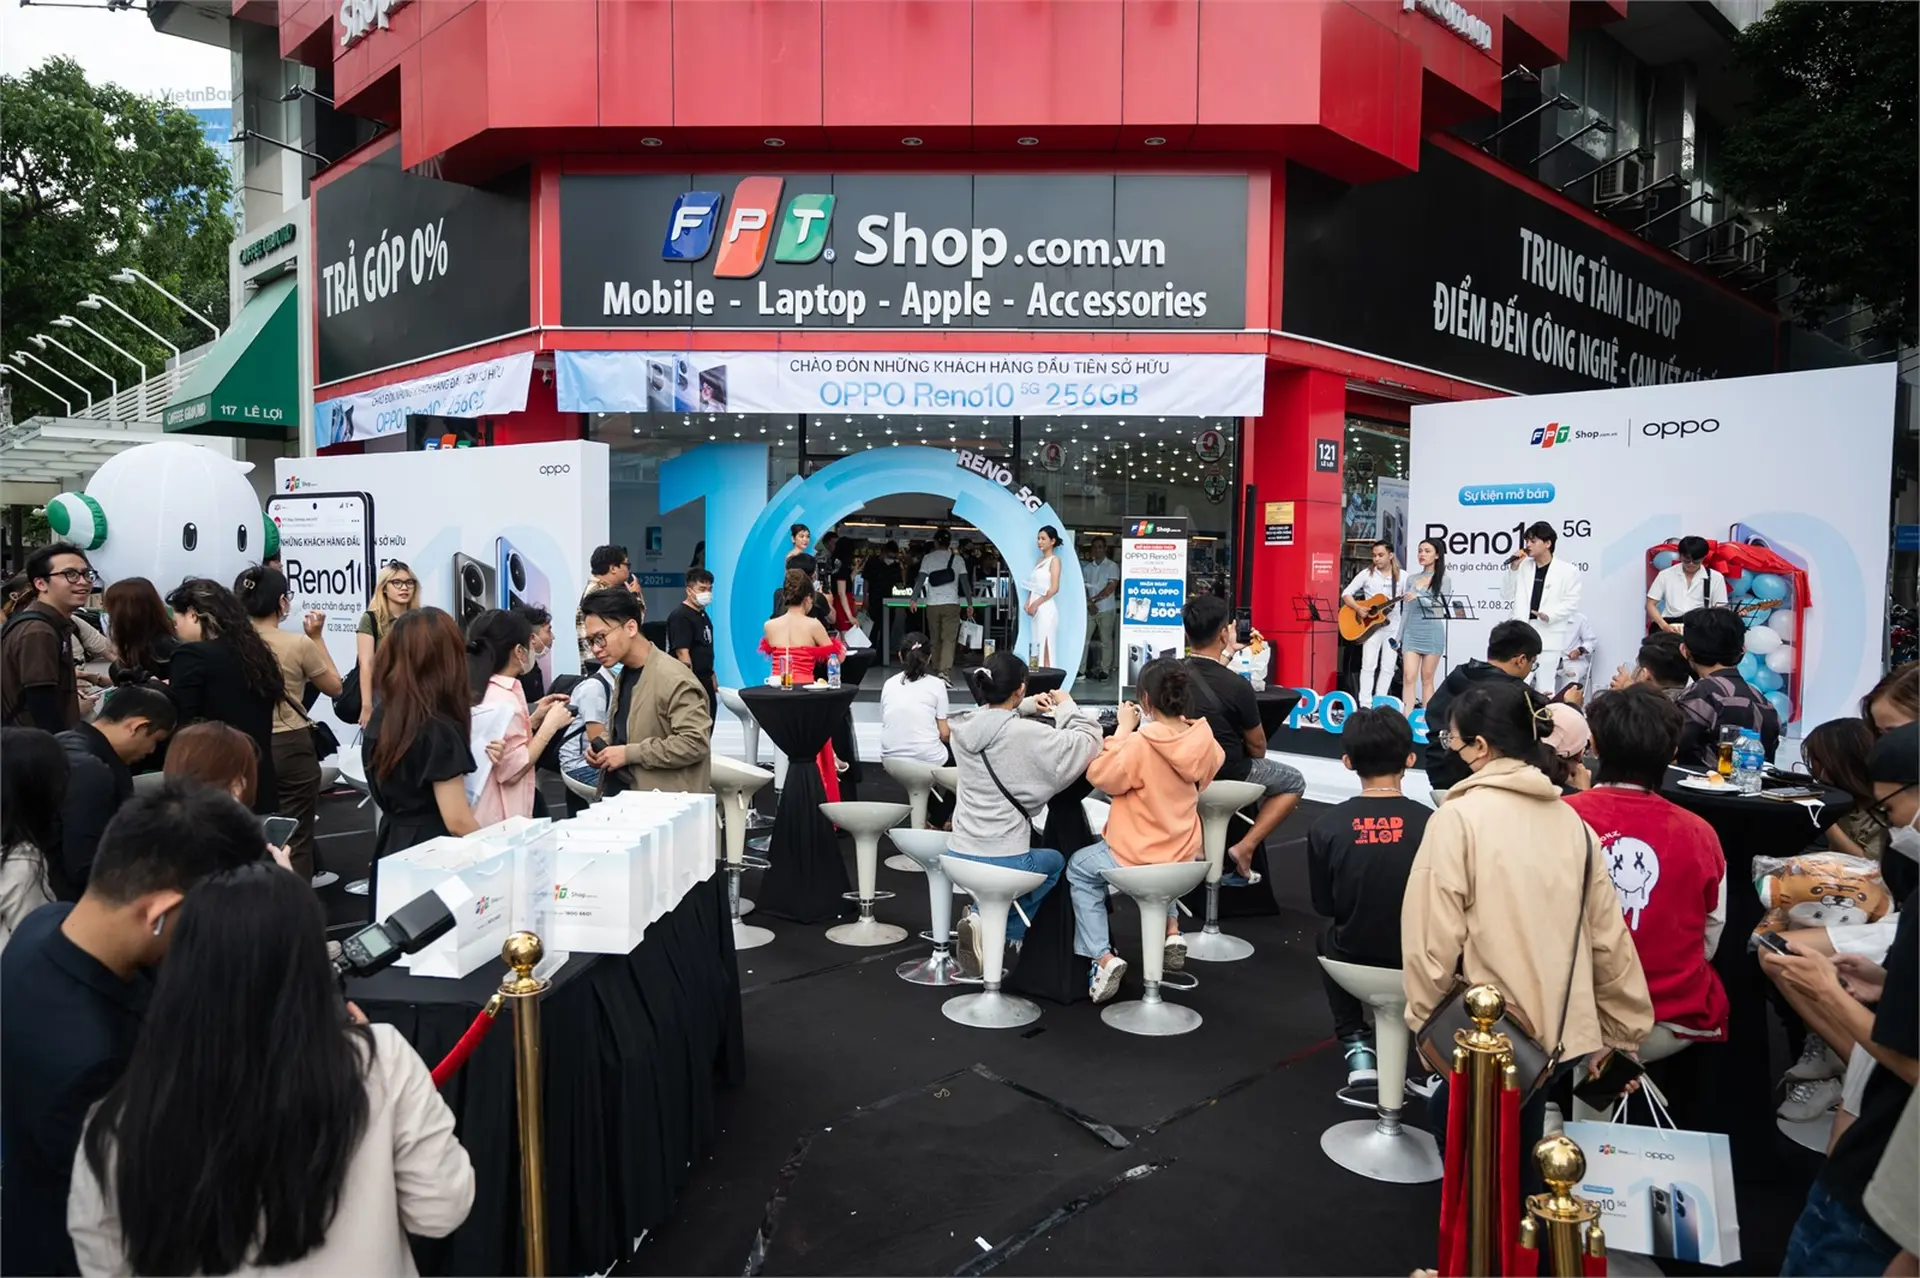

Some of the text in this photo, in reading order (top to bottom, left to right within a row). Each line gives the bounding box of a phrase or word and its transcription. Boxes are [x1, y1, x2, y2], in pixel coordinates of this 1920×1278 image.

[323, 217, 448, 317] TRẢ GÓP 0%
[1519, 227, 1681, 340] TRUNG TÂM LAPTOP
[603, 280, 715, 315] Mobile
[758, 281, 866, 325] Laptop
[901, 281, 991, 325] Apple
[1027, 281, 1207, 318] Accessories
[1433, 274, 1486, 344] ĐIỂM
[1490, 294, 1528, 357] ĐẾN
[1532, 311, 1576, 371] CÔNG
[790, 356, 1170, 374] CHÀO ĐÓN NHỮNG KHÁCH HÀNG ĐẦU TIÊN SỞ HỮU
[819, 381, 1139, 408] OPPO Reno10 5G 256GB
[221, 405, 283, 420] 117 LÊ LỢI
[376, 408, 403, 432] OPPO
[1532, 427, 1568, 443] FPT
[1642, 418, 1720, 439] oppo
[1318, 443, 1336, 461] 121
[539, 463, 570, 477] oppo
[958, 450, 1043, 513] RENO 5G
[1464, 487, 1549, 504] Sự kiện mở bán
[303, 536, 326, 547] KHÁCH
[327, 535, 345, 547] HÀNG
[1425, 519, 1592, 555] Reno1 5G
[1125, 552, 1148, 560] OPPO
[1460, 562, 1474, 573] gia
[1475, 561, 1499, 571] chân
[338, 601, 355, 612] dung
[1645, 1151, 1675, 1161] oppo
